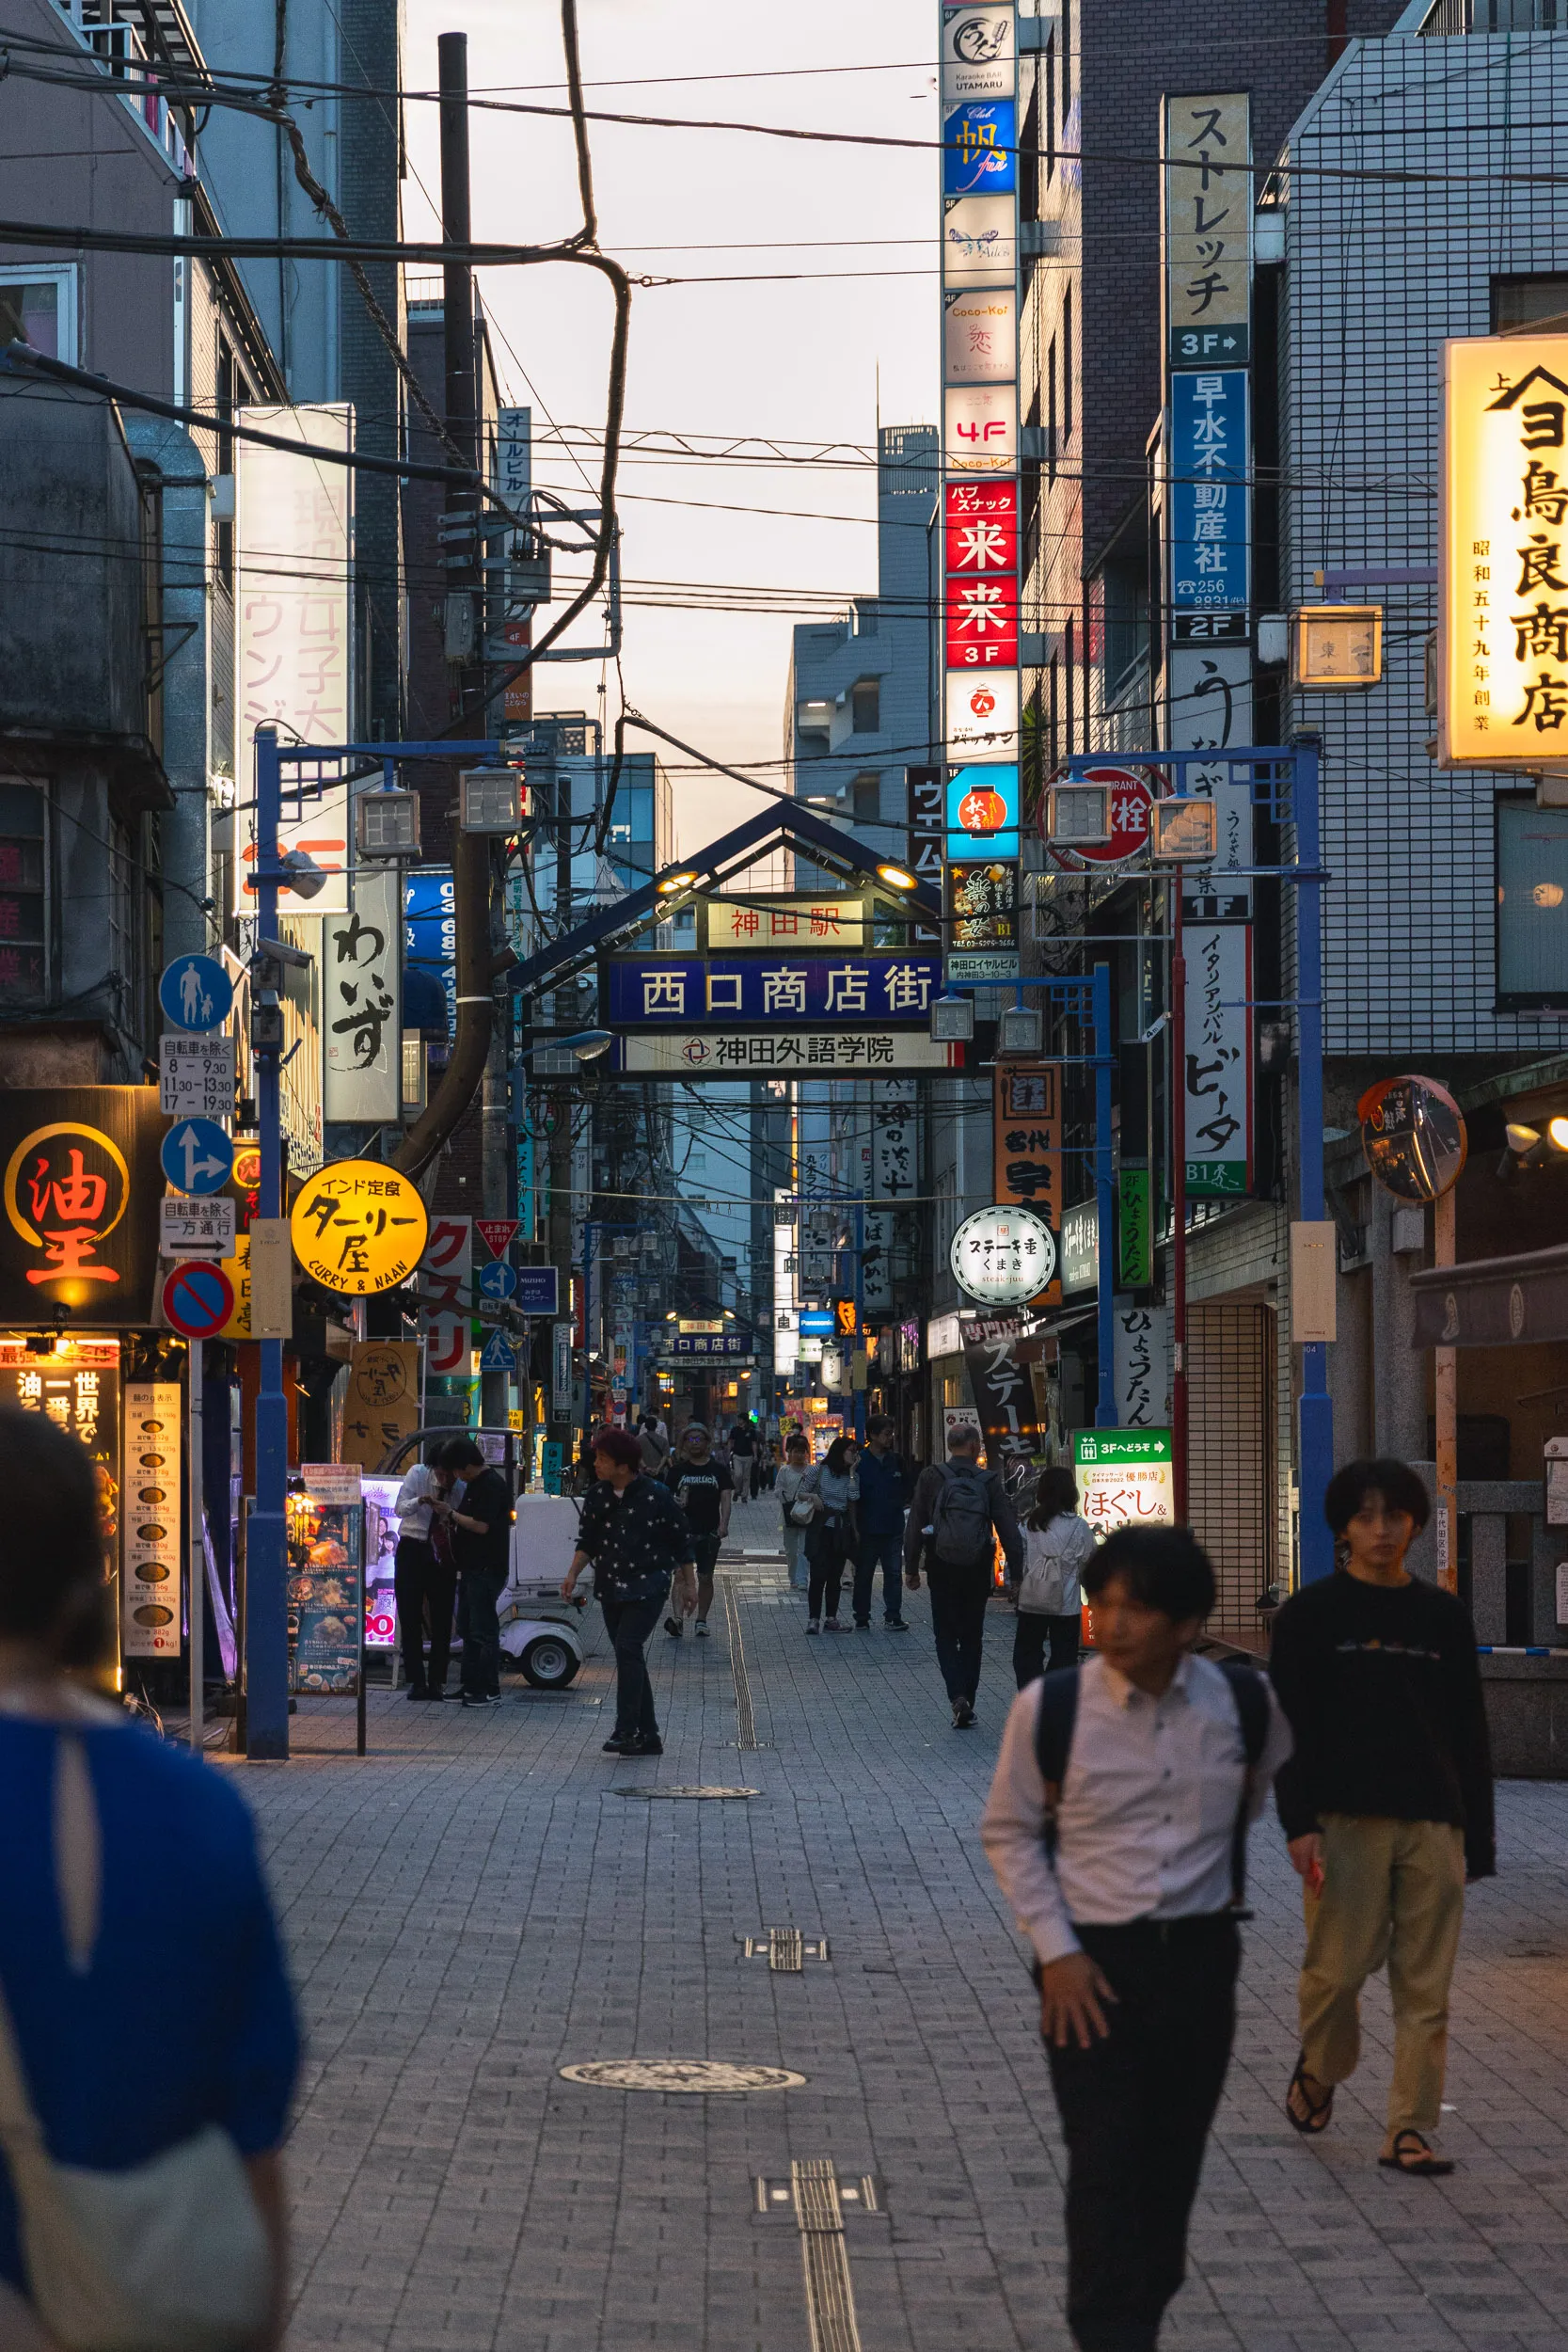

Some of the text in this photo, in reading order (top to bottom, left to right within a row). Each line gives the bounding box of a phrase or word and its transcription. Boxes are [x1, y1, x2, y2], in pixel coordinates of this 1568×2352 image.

[956, 81, 1003, 90] UTAMARU
[967, 106, 996, 119] Club
[956, 120, 1007, 165] 帆
[1186, 108, 1229, 315] ストレッチ
[952, 306, 1008, 317] Coco-Koi
[1180, 334, 1218, 355] 3F
[957, 421, 1006, 442] 4F
[951, 456, 1012, 469] Coco-Koi
[1192, 376, 1228, 575] 早水不動産社
[951, 485, 979, 500] パブ
[958, 497, 1011, 511] スナック
[1197, 580, 1225, 593] 256
[1190, 616, 1231, 636] 2F
[293, 488, 344, 798] 現役女子大
[1473, 539, 1491, 731] 昭和五十九年創業
[964, 645, 999, 663] 3F
[948, 769, 958, 777] 1F
[1192, 897, 1234, 917] 1F
[731, 908, 840, 938] 神田駅
[997, 923, 1012, 936] B1
[950, 960, 1017, 970] 神田ロイヤルビル
[957, 970, 1012, 979] 内神田3-10-3
[641, 965, 932, 1015] 西口商店街
[1201, 934, 1224, 1044] イタリアンバル
[165, 1041, 230, 1056] 自転車を除く
[716, 1036, 894, 1065] 神田外語学院
[1186, 1164, 1208, 1180] B1
[322, 1180, 401, 1197] インド定食
[166, 1202, 230, 1217] 自転車を除く
[303, 1194, 418, 1240] ターリー
[166, 1221, 230, 1236] 一方通行
[484, 1225, 511, 1233] 止まれ
[1122, 1190, 1142, 1282] ひょうたん
[338, 1234, 369, 1272] 屋
[969, 1238, 1037, 1255] ステーキ重
[984, 1259, 1022, 1271] くまき
[309, 1260, 408, 1291] CURRY & NAAN
[425, 1222, 467, 1372] クスリ
[964, 1319, 1021, 1343] 専門店
[663, 1338, 741, 1352] 西口商店街
[1122, 1311, 1153, 1426] ひょうたん
[74, 1371, 100, 1444] 世界で
[1101, 1443, 1150, 1454] 3Fへどうぞ
[678, 1475, 719, 1492] METALLICA
[1126, 1471, 1158, 1482] 優勝店
[1438, 1510, 1447, 1568] 千代田区役所
